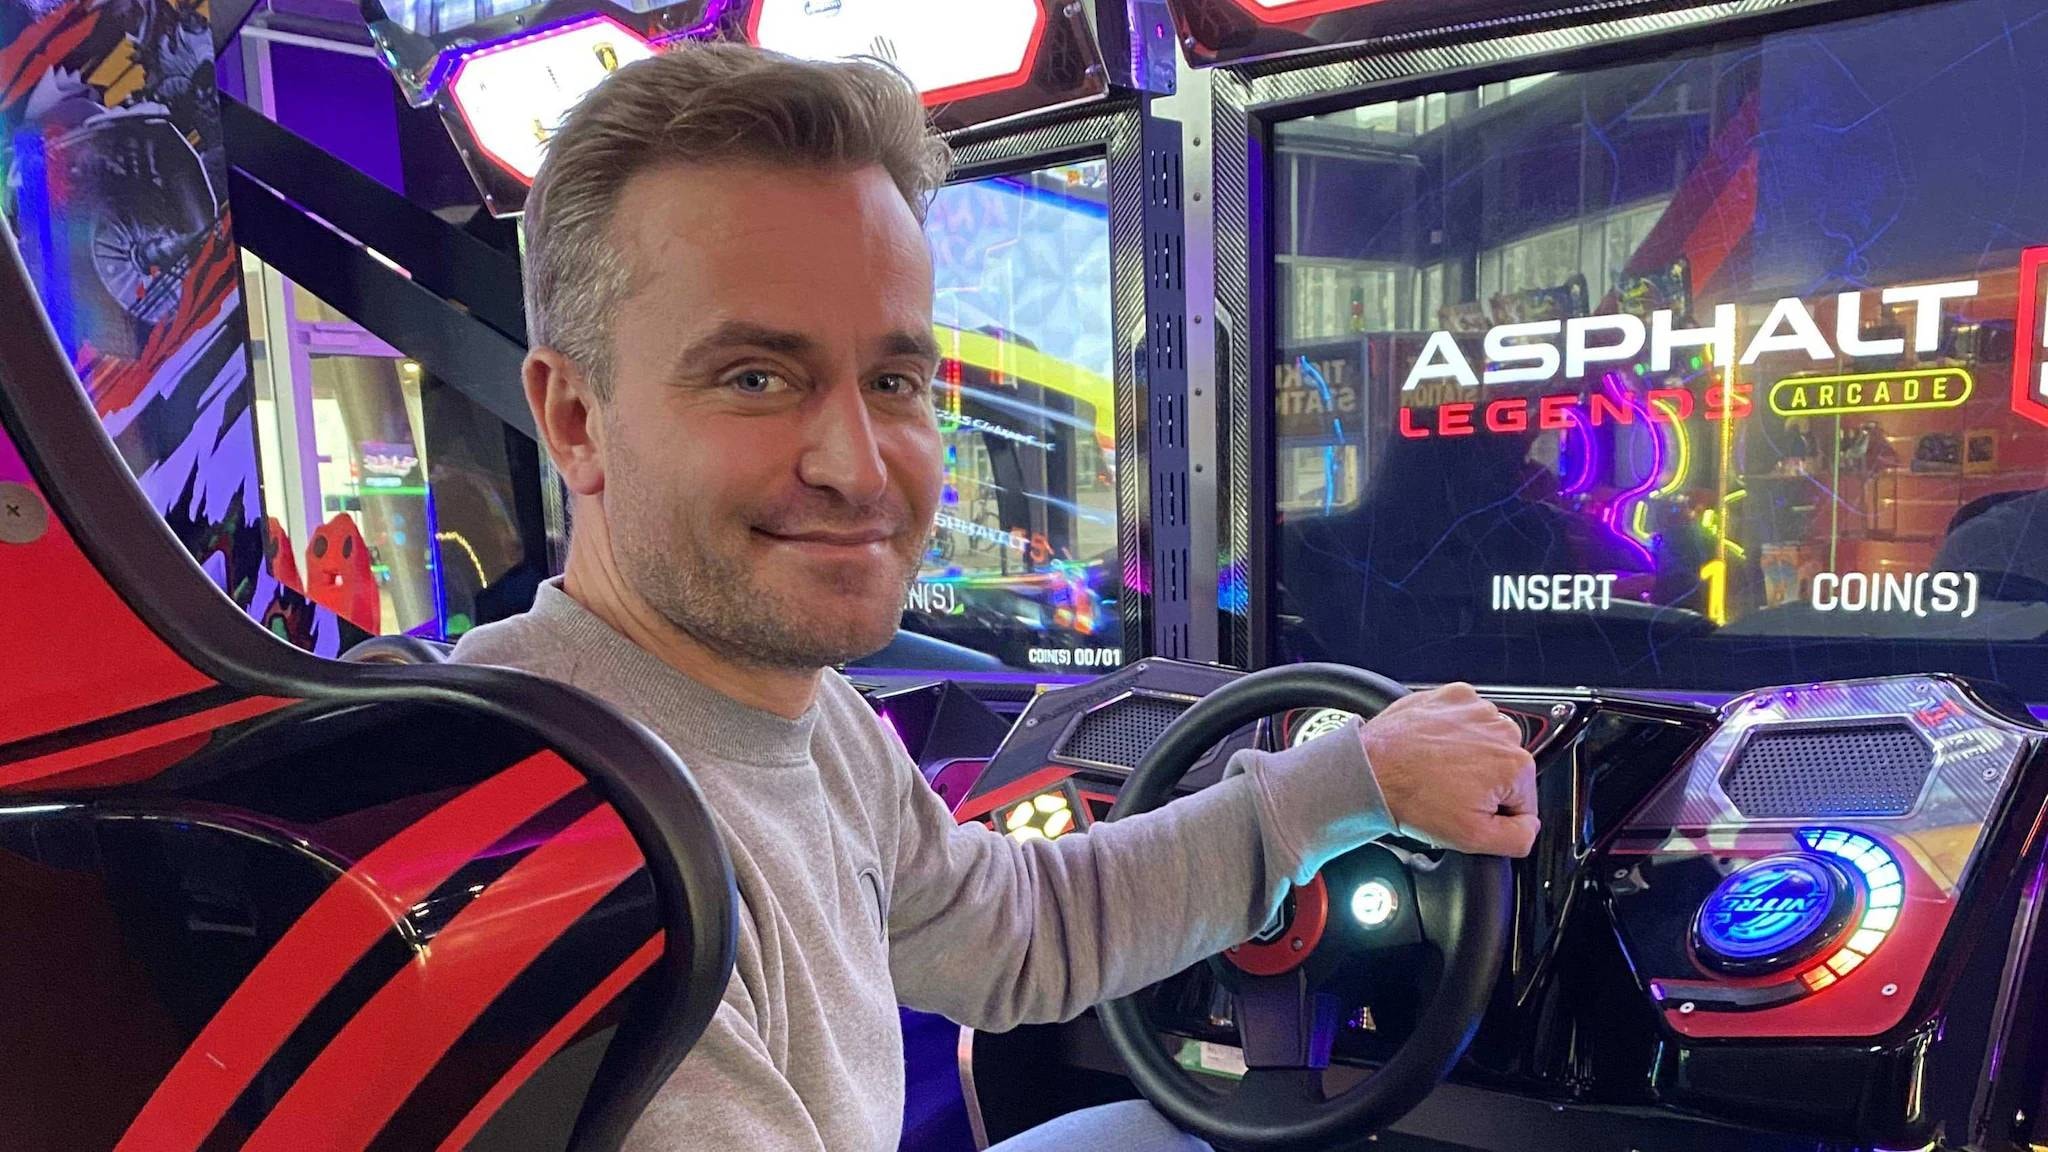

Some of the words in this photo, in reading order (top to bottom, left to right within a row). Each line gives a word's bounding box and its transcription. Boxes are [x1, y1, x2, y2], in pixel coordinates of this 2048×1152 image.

[1401, 280, 1979, 392] ASPHALT
[1399, 382, 1754, 440] LEGENDS
[1791, 376, 1950, 409] ARCADE
[1491, 573, 1618, 612] INSERT
[1699, 559, 1727, 621] 1
[1811, 571, 1980, 619] COIN(S)
[1028, 648, 1071, 665] COIN(S)
[1074, 648, 1121, 667] 00/01
